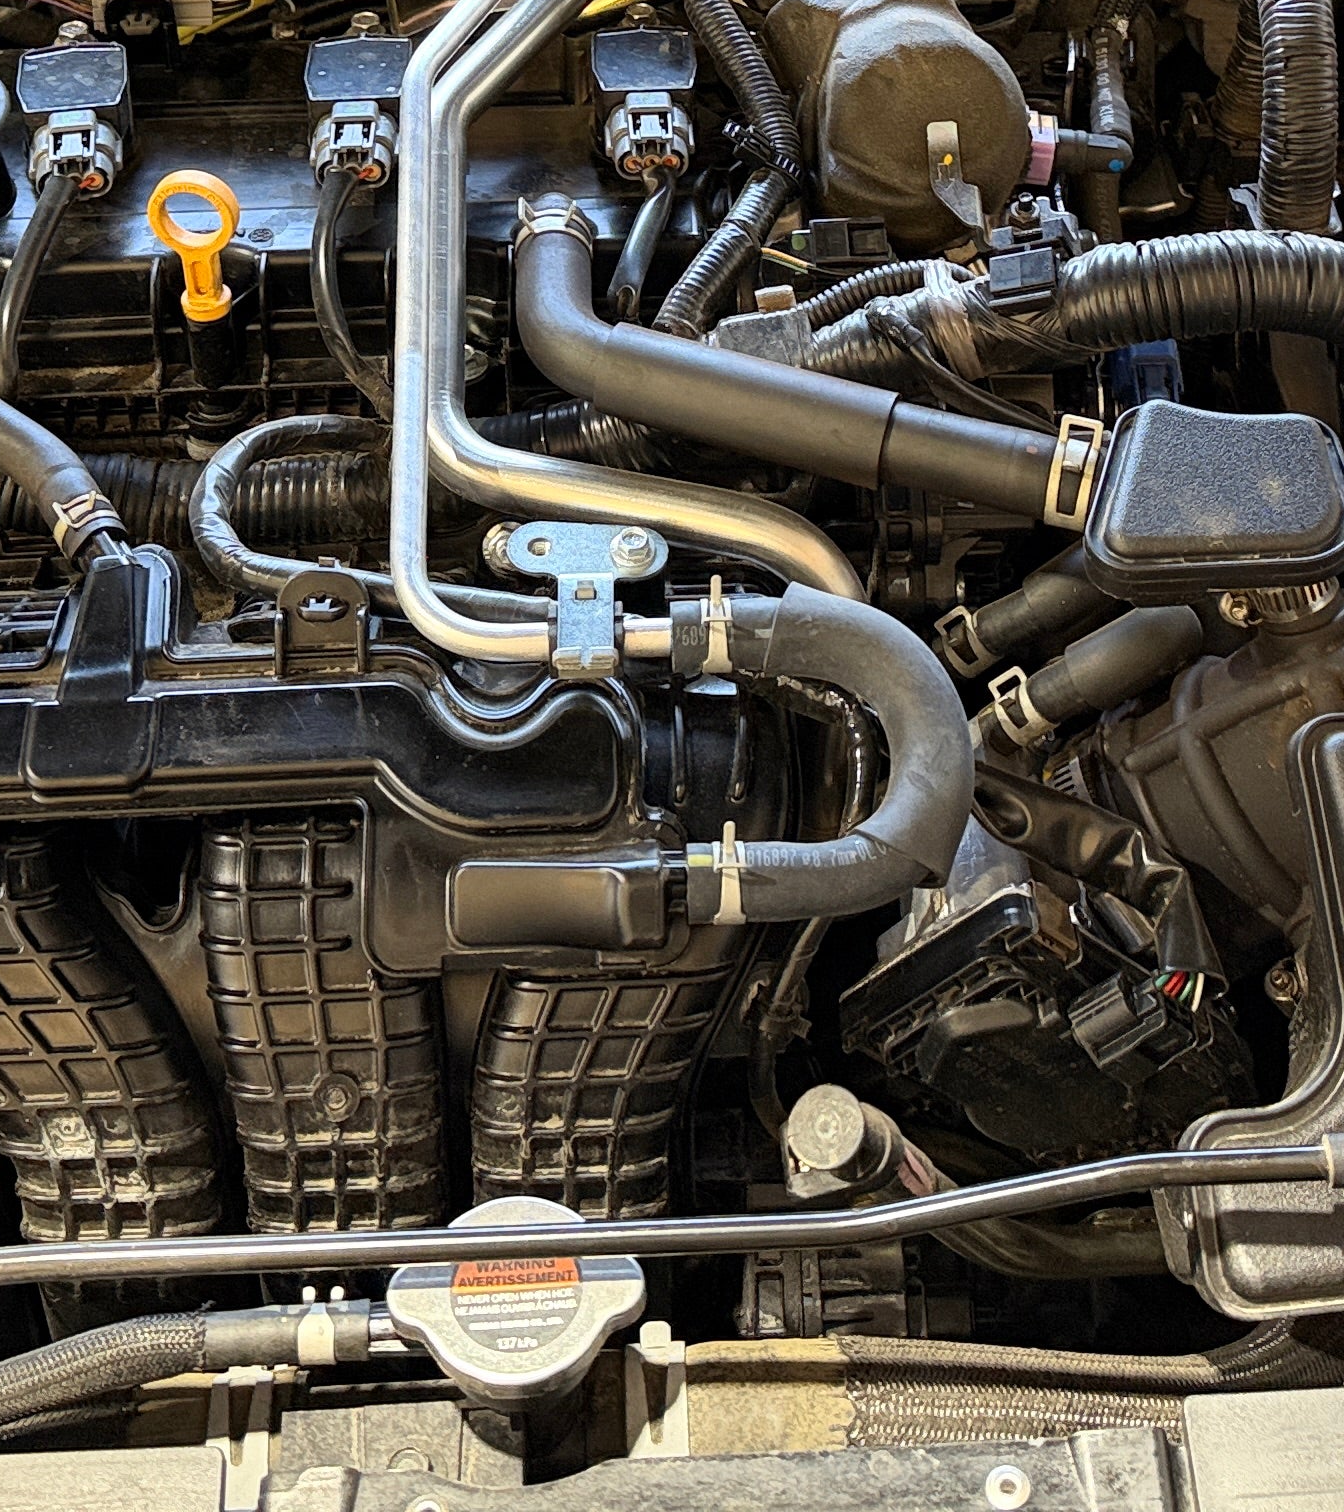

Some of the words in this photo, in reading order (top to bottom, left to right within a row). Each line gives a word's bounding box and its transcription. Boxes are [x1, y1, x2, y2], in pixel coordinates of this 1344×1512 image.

[476, 1259, 556, 1273] WARNING
[458, 1270, 574, 1287] AVERTISSEMENT
[457, 1294, 490, 1304] NEVER
[490, 1292, 519, 1303] OPEN
